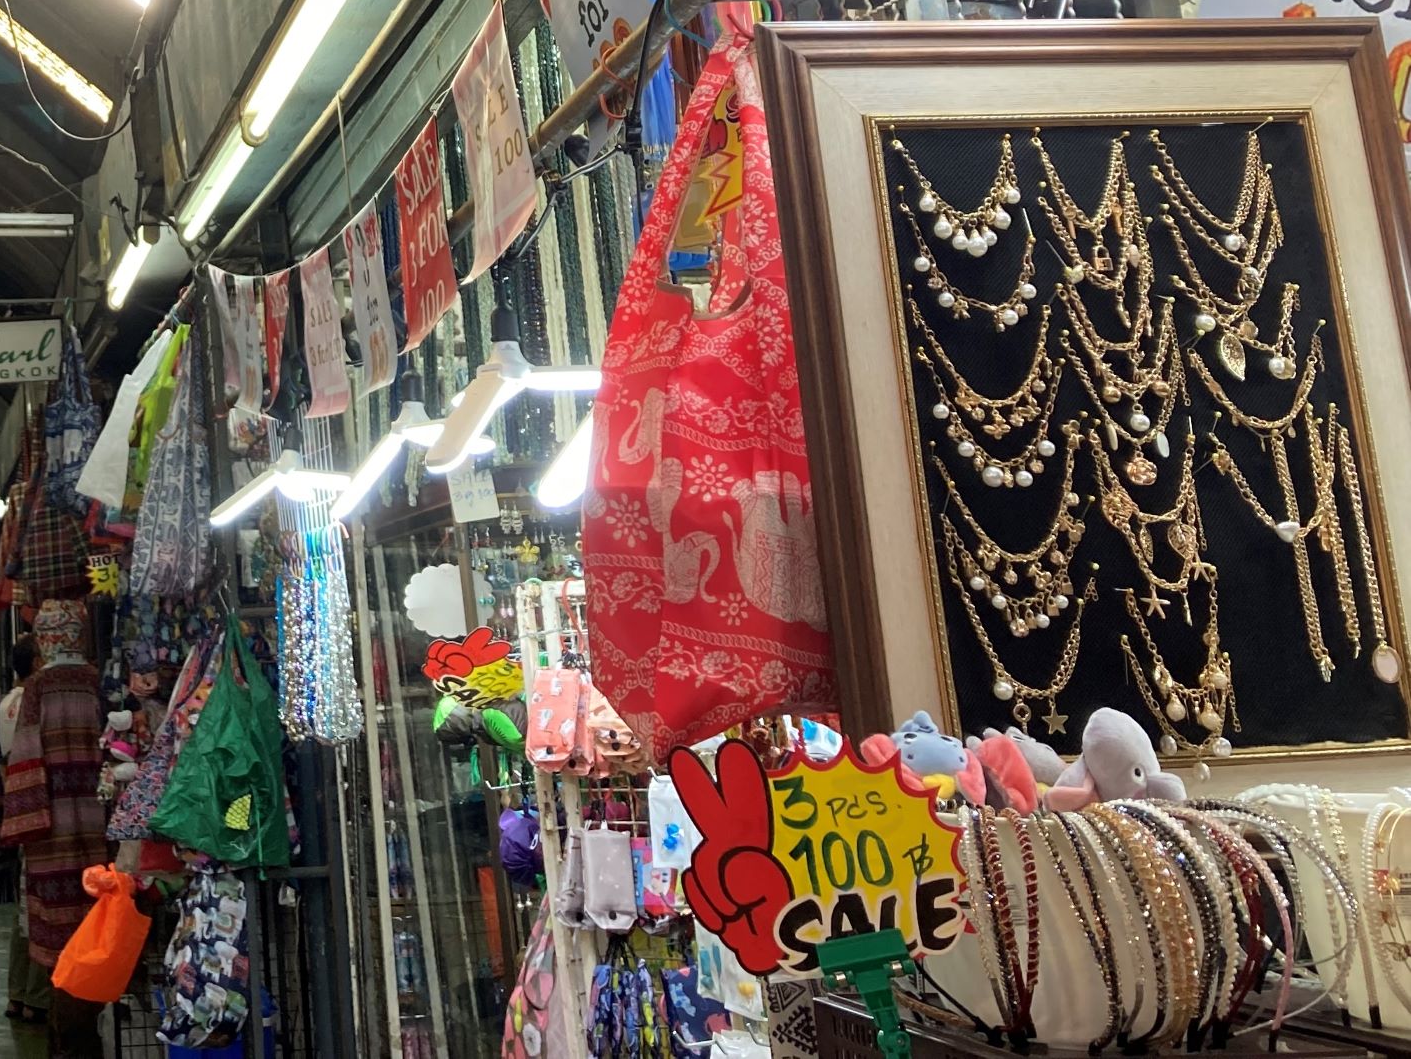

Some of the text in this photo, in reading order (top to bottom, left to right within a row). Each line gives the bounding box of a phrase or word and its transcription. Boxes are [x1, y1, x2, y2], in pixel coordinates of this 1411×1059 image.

[400, 140, 439, 217] SALE
[494, 127, 524, 176] 100
[419, 278, 446, 333] 100
[772, 775, 819, 830] 3
[789, 829, 894, 896] 100
